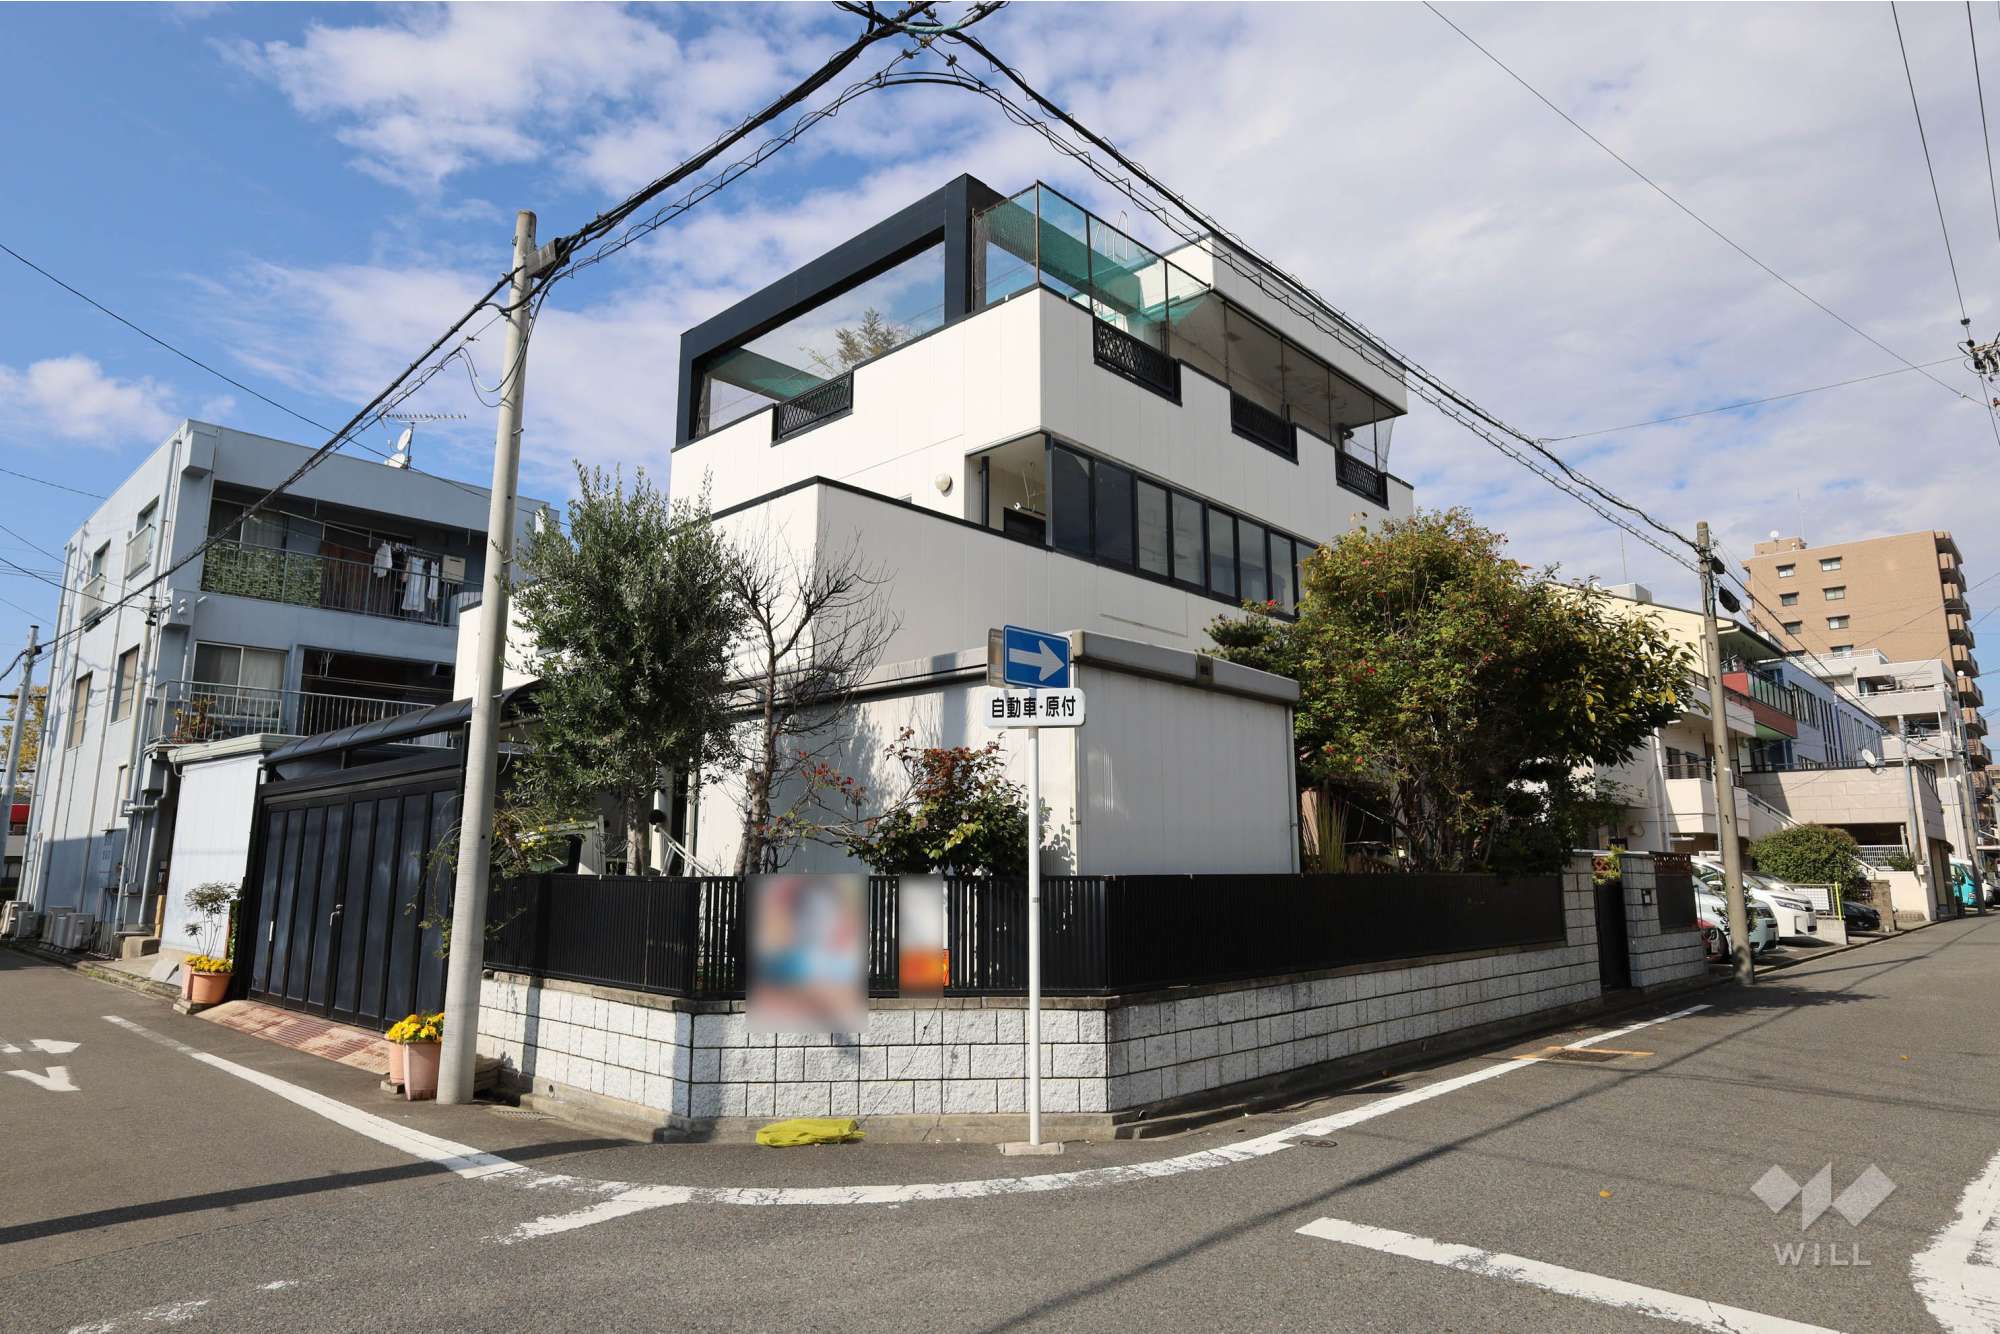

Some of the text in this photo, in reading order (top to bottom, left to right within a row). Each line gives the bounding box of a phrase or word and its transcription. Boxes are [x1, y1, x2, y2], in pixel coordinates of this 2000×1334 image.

[991, 696, 1076, 719] 自動車・原付
